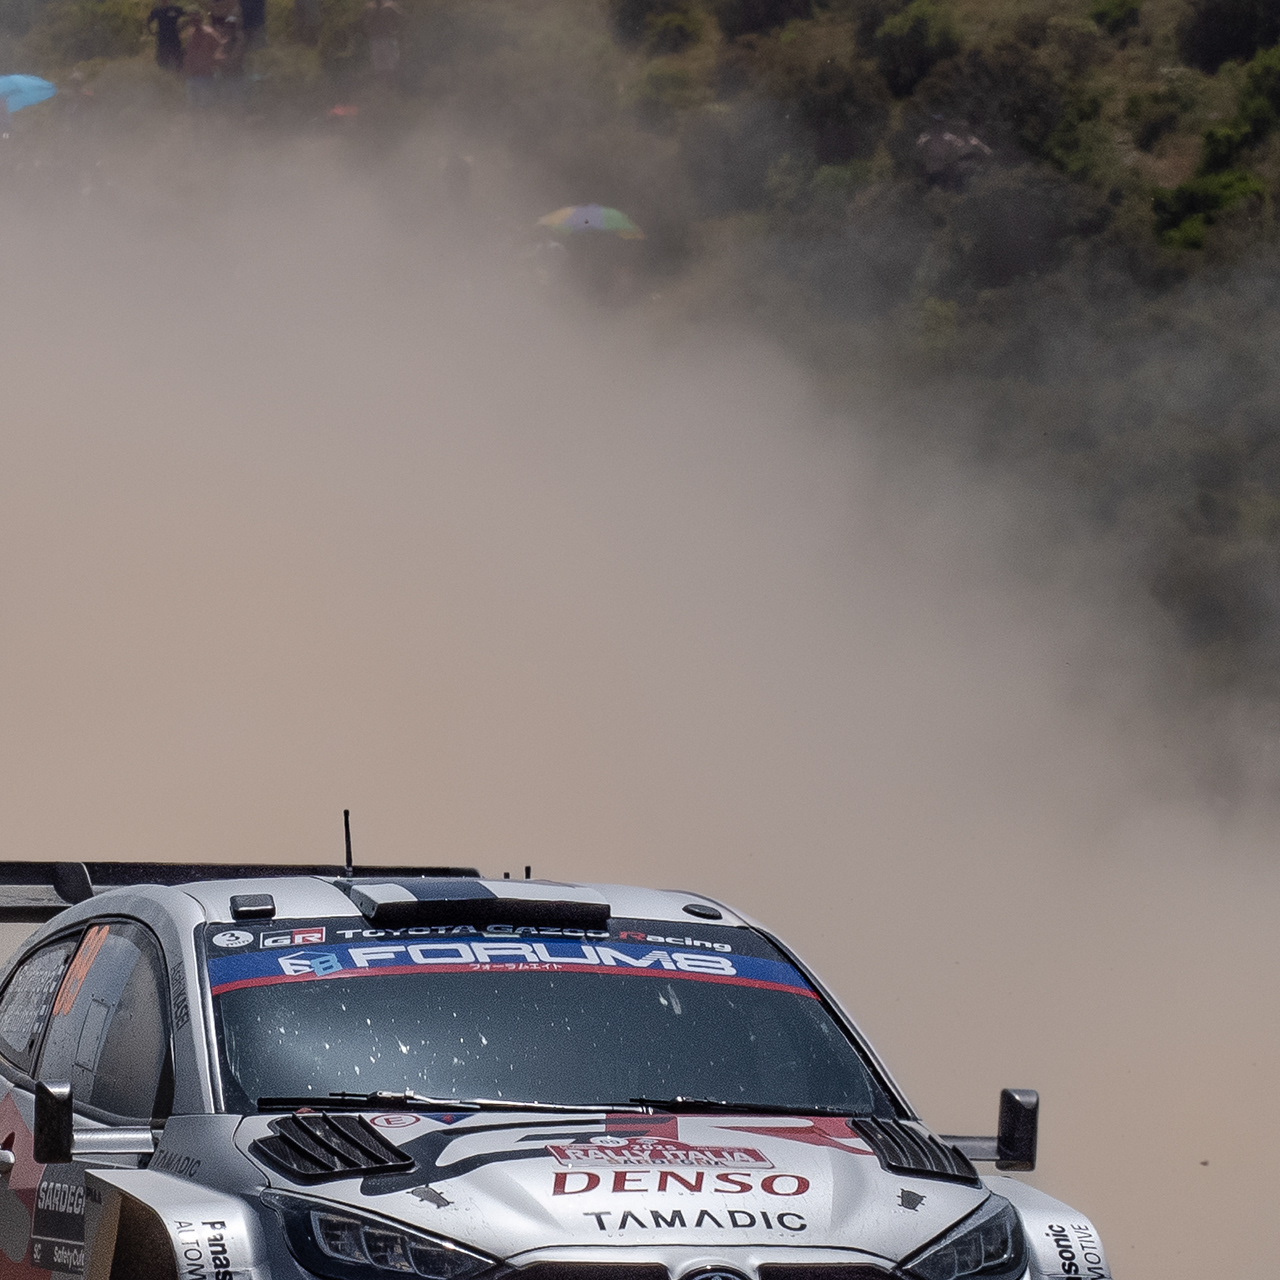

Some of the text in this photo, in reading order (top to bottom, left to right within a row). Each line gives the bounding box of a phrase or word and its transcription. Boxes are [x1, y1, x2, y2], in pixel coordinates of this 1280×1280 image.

[221, 932, 240, 942] 3
[263, 932, 322, 947] GR
[336, 924, 732, 953] TOYOTA GAZOO Racing
[348, 943, 737, 976] FORUM8
[384, 1116, 404, 1125] E
[564, 1149, 756, 1163] RALLY ITALIA
[552, 1170, 810, 1196] DENSO
[583, 1209, 808, 1232] TAMADIC
